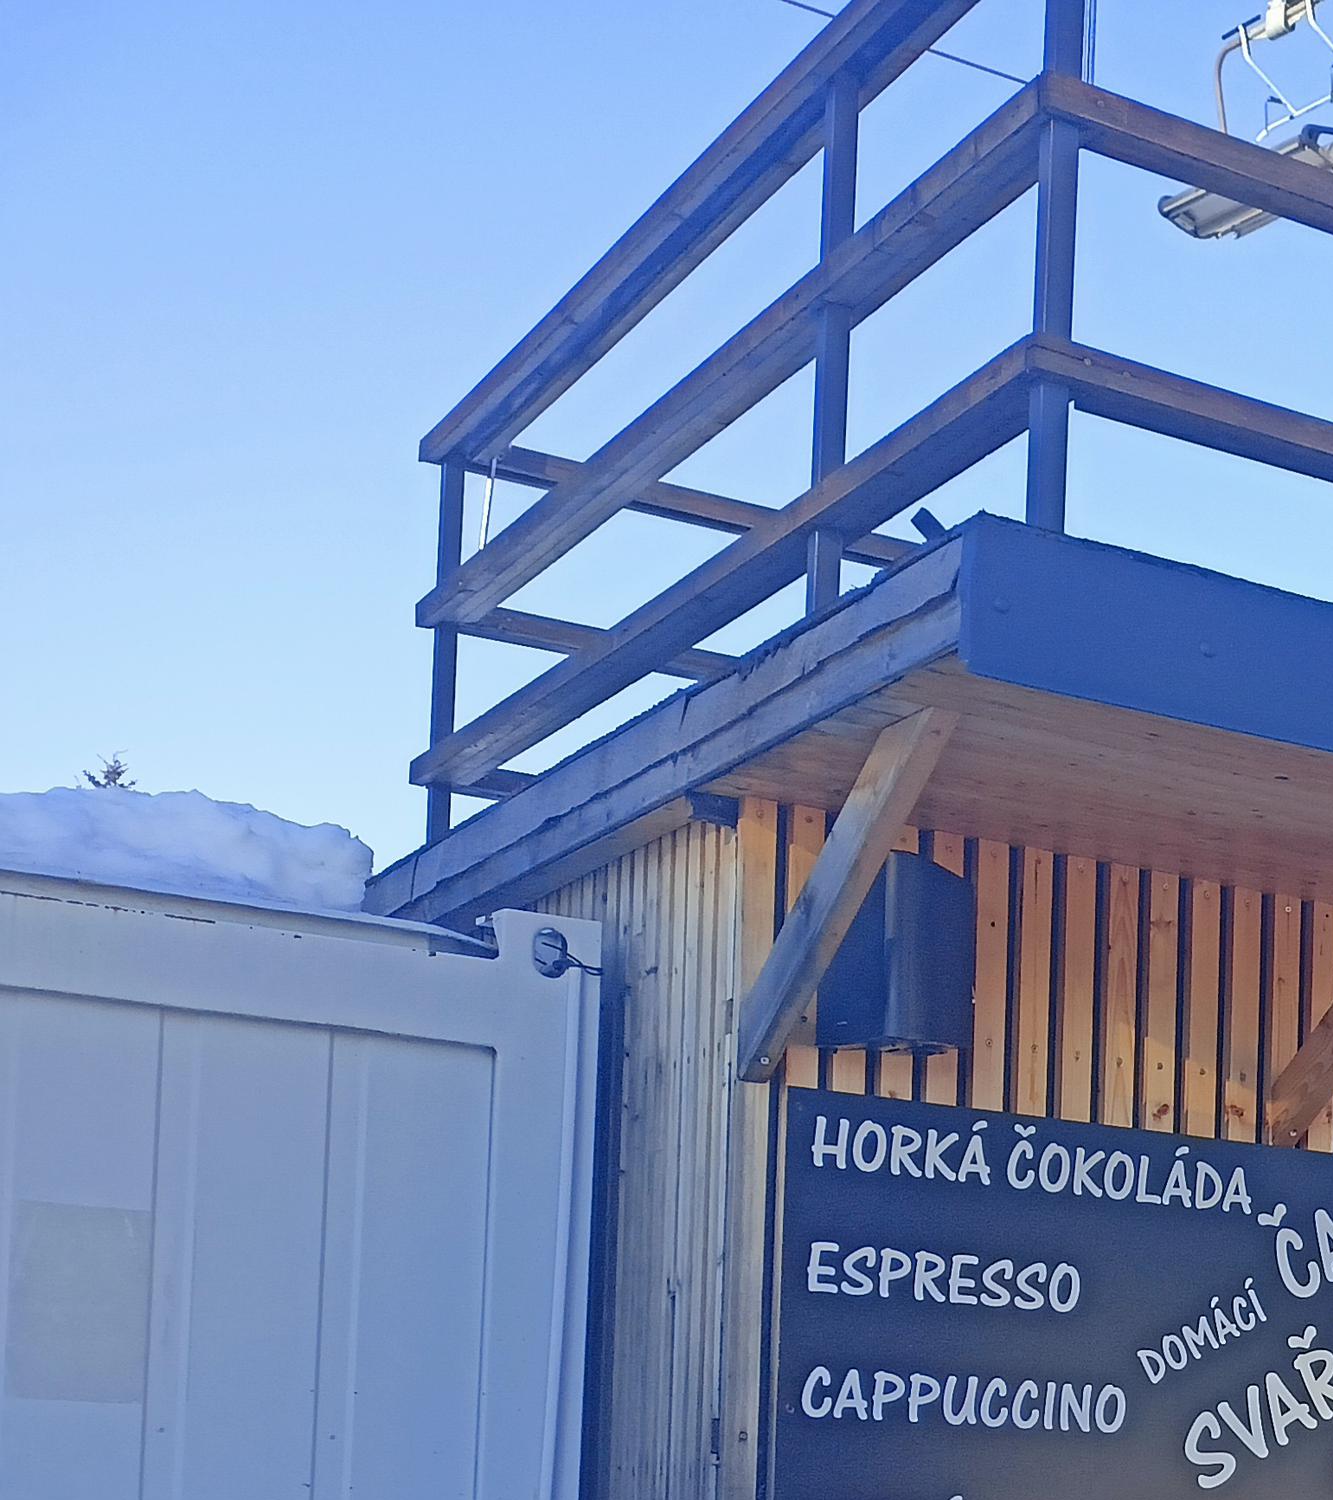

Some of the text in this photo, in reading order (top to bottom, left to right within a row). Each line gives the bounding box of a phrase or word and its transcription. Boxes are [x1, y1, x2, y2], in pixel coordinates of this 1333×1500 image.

[812, 1116, 1252, 1216] HORKÁ ČOKOLÁDA
[807, 1242, 1081, 1313] ESPRESSO
[1137, 1278, 1267, 1384] DOMÁCÍ
[801, 1366, 1126, 1433] CAPPUCCINO
